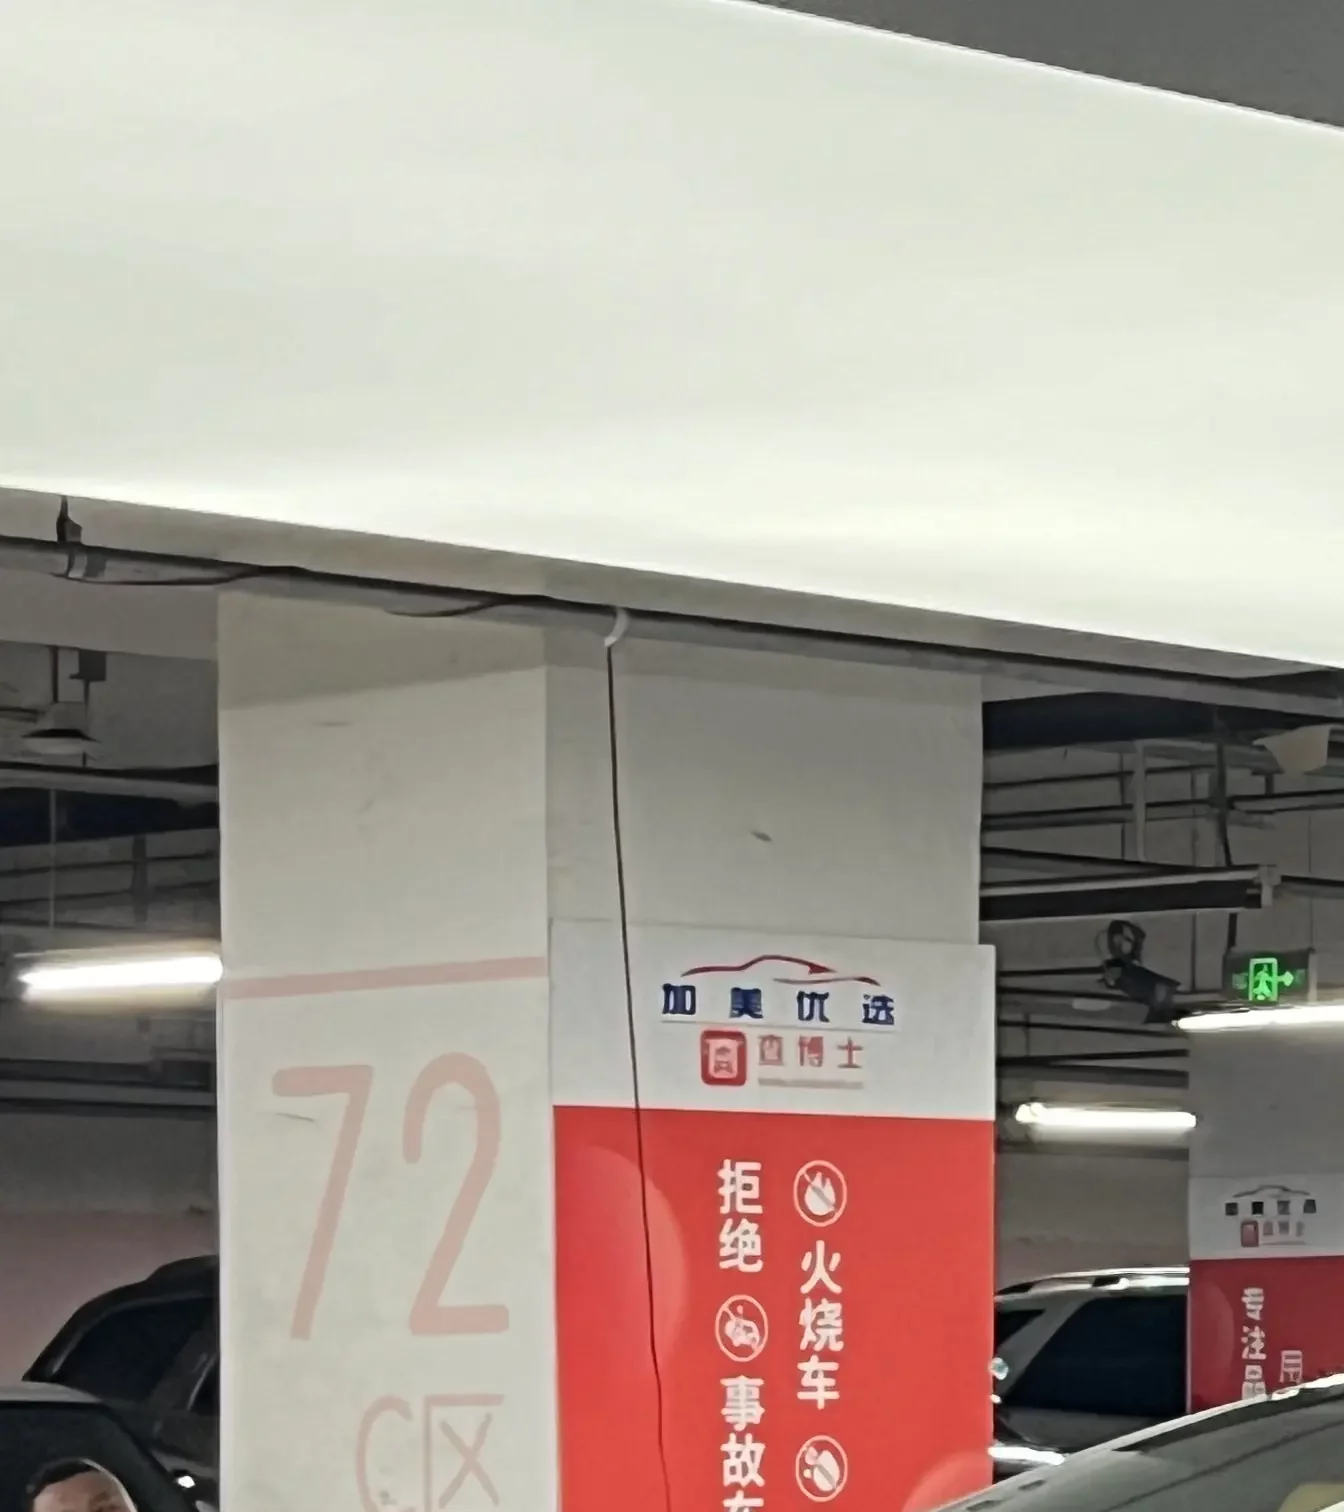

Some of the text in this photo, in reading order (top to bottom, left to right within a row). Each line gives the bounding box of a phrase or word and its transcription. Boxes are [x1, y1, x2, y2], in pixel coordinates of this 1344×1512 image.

[661, 983, 895, 1026] 加美优选
[271, 1052, 510, 1341] 72
[717, 1158, 764, 1273] 拒绝
[797, 1239, 845, 1410] 火烧车
